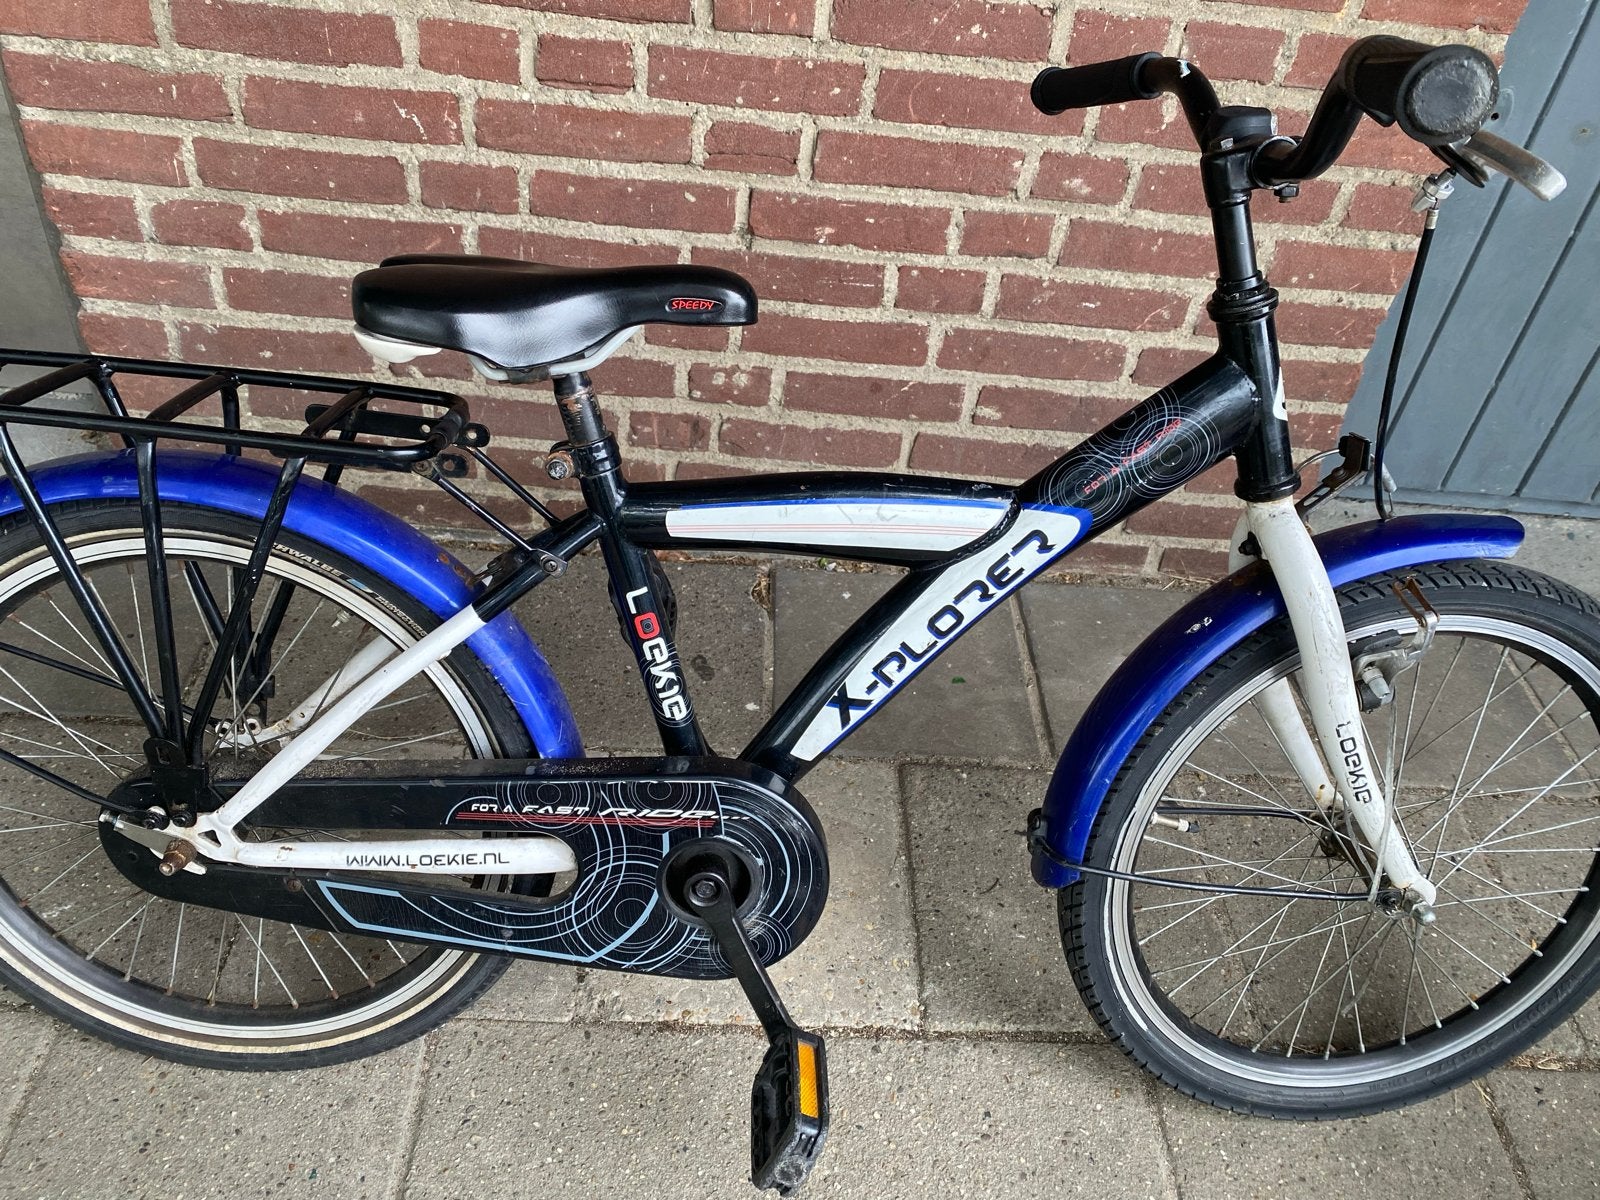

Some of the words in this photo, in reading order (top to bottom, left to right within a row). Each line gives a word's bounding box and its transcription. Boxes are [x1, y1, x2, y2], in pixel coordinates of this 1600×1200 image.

[671, 300, 714, 310] SPEEDY
[825, 529, 1057, 731] X-PLORER
[471, 803, 498, 813] FOR
[503, 804, 513, 813] A
[521, 804, 589, 815] FAST
